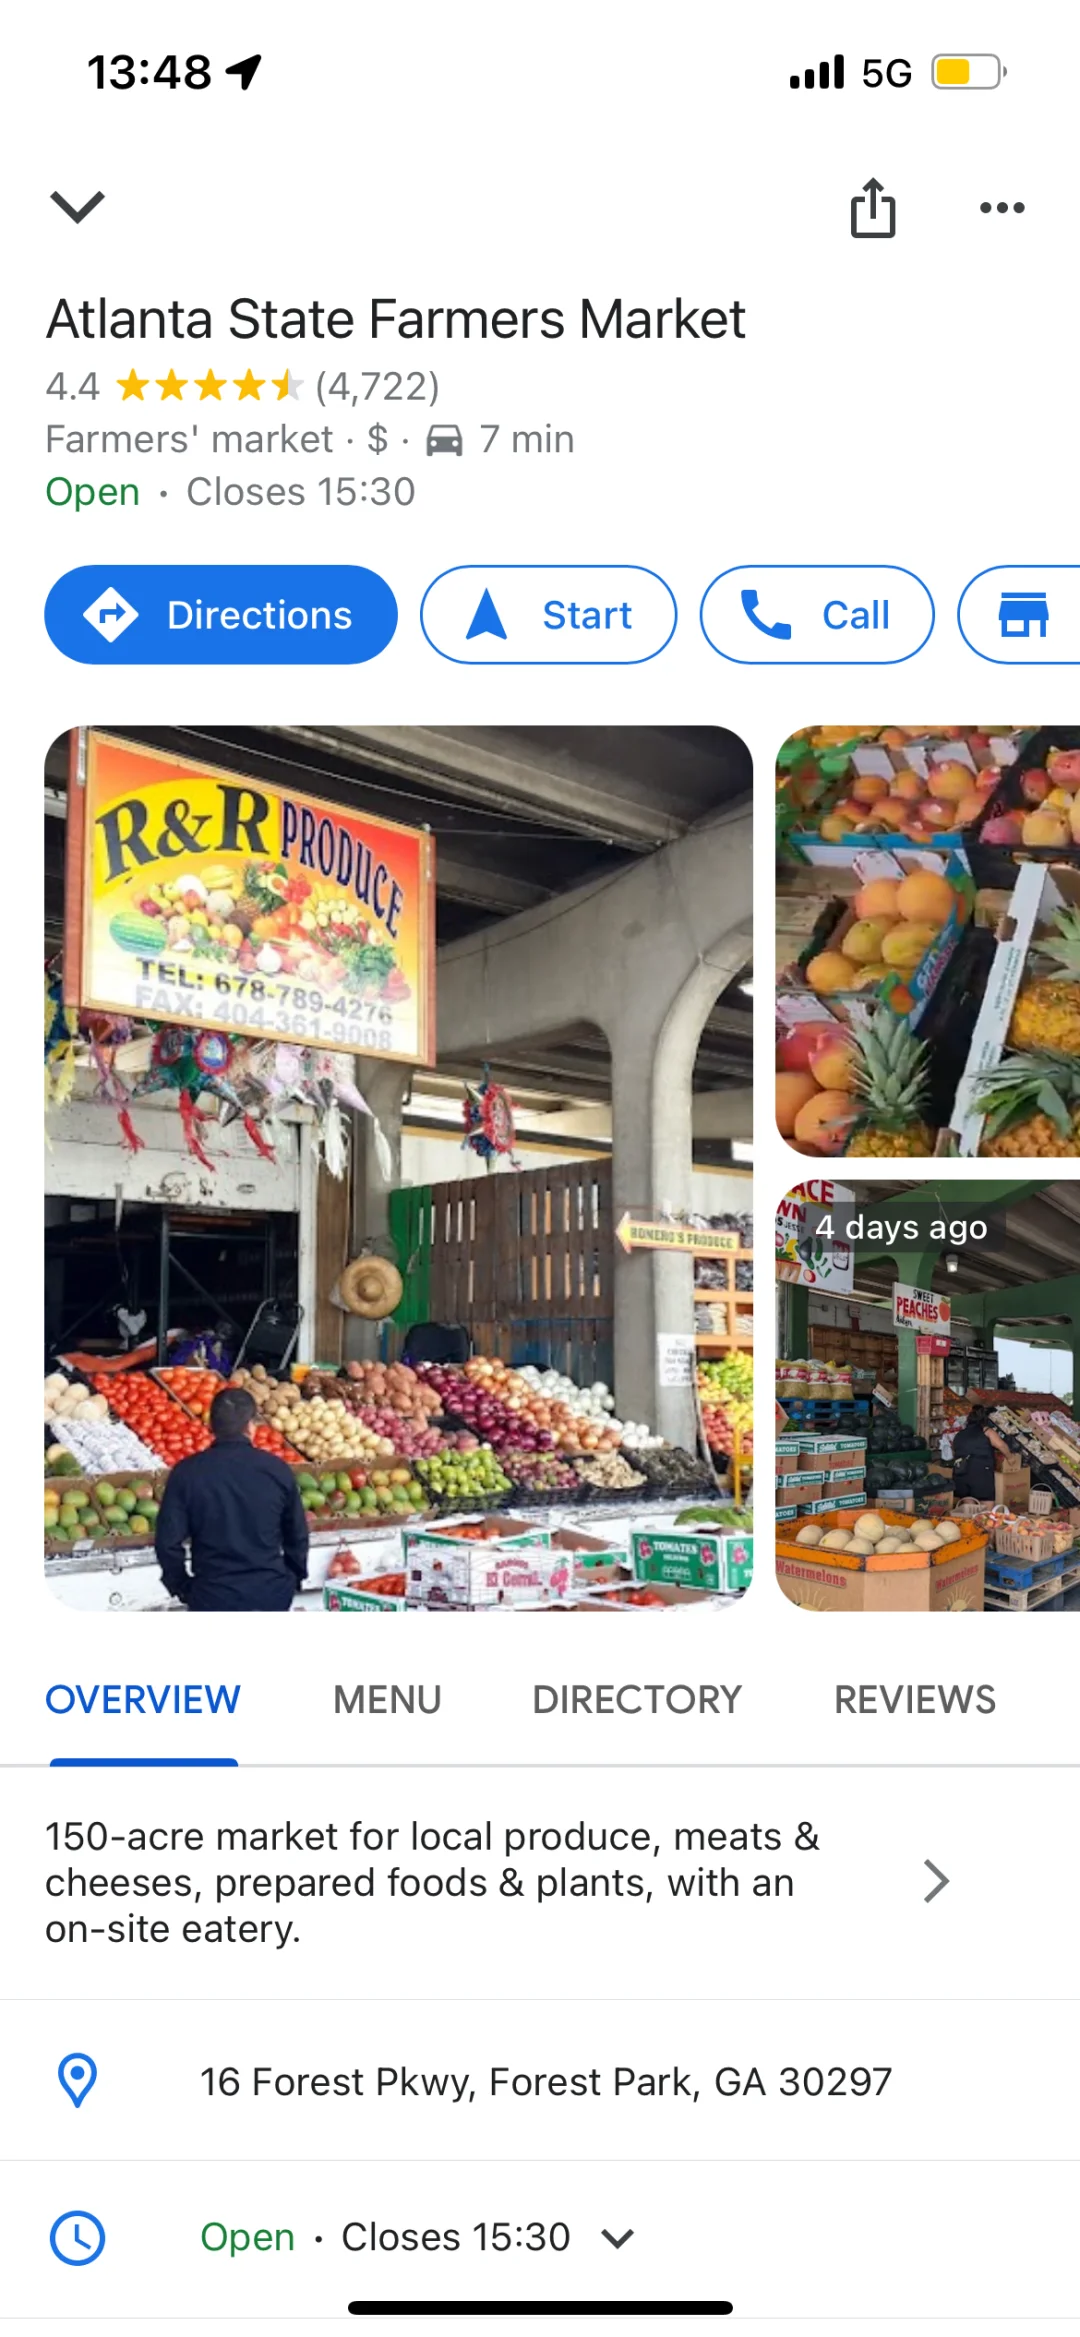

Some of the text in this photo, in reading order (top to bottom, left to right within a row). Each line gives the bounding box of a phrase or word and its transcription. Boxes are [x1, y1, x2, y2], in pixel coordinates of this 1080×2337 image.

[88, 54, 211, 90] 13:48
[863, 58, 911, 88] 5G
[46, 297, 746, 339] Atlanta State Farmers Market
[46, 371, 438, 407] 4.4 (4,722)
[48, 422, 573, 455] Farmers' market $ 7 min
[46, 476, 415, 512] Open Closes 15:30
[169, 599, 352, 630] Directions
[544, 600, 632, 630] Start
[823, 600, 888, 630] Call
[95, 783, 404, 939] R&R PRODUCE
[135, 957, 393, 1026] TEL: 678-789-4276
[134, 984, 393, 1051] FAX: 404-361-9008
[896, 1296, 939, 1321] PEACHES
[912, 1289, 935, 1304] SWEET
[652, 1541, 699, 1555] TOMATES
[46, 1684, 241, 1714] OVERVIEW
[335, 1685, 440, 1714] MENU
[534, 1684, 742, 1714] DIRECTORY
[836, 1684, 995, 1714] REVIEWS
[46, 1821, 820, 1857] 150-acre market for local produce, meats &
[46, 1867, 793, 1903] cheeses, prepared foods & plants, with an
[46, 1913, 299, 1950] on-site eatery.
[201, 2066, 892, 2103] 16 Forest Pkwy, Forest Park, GA 30297
[201, 2221, 570, 2258] Open Closes 15:30
